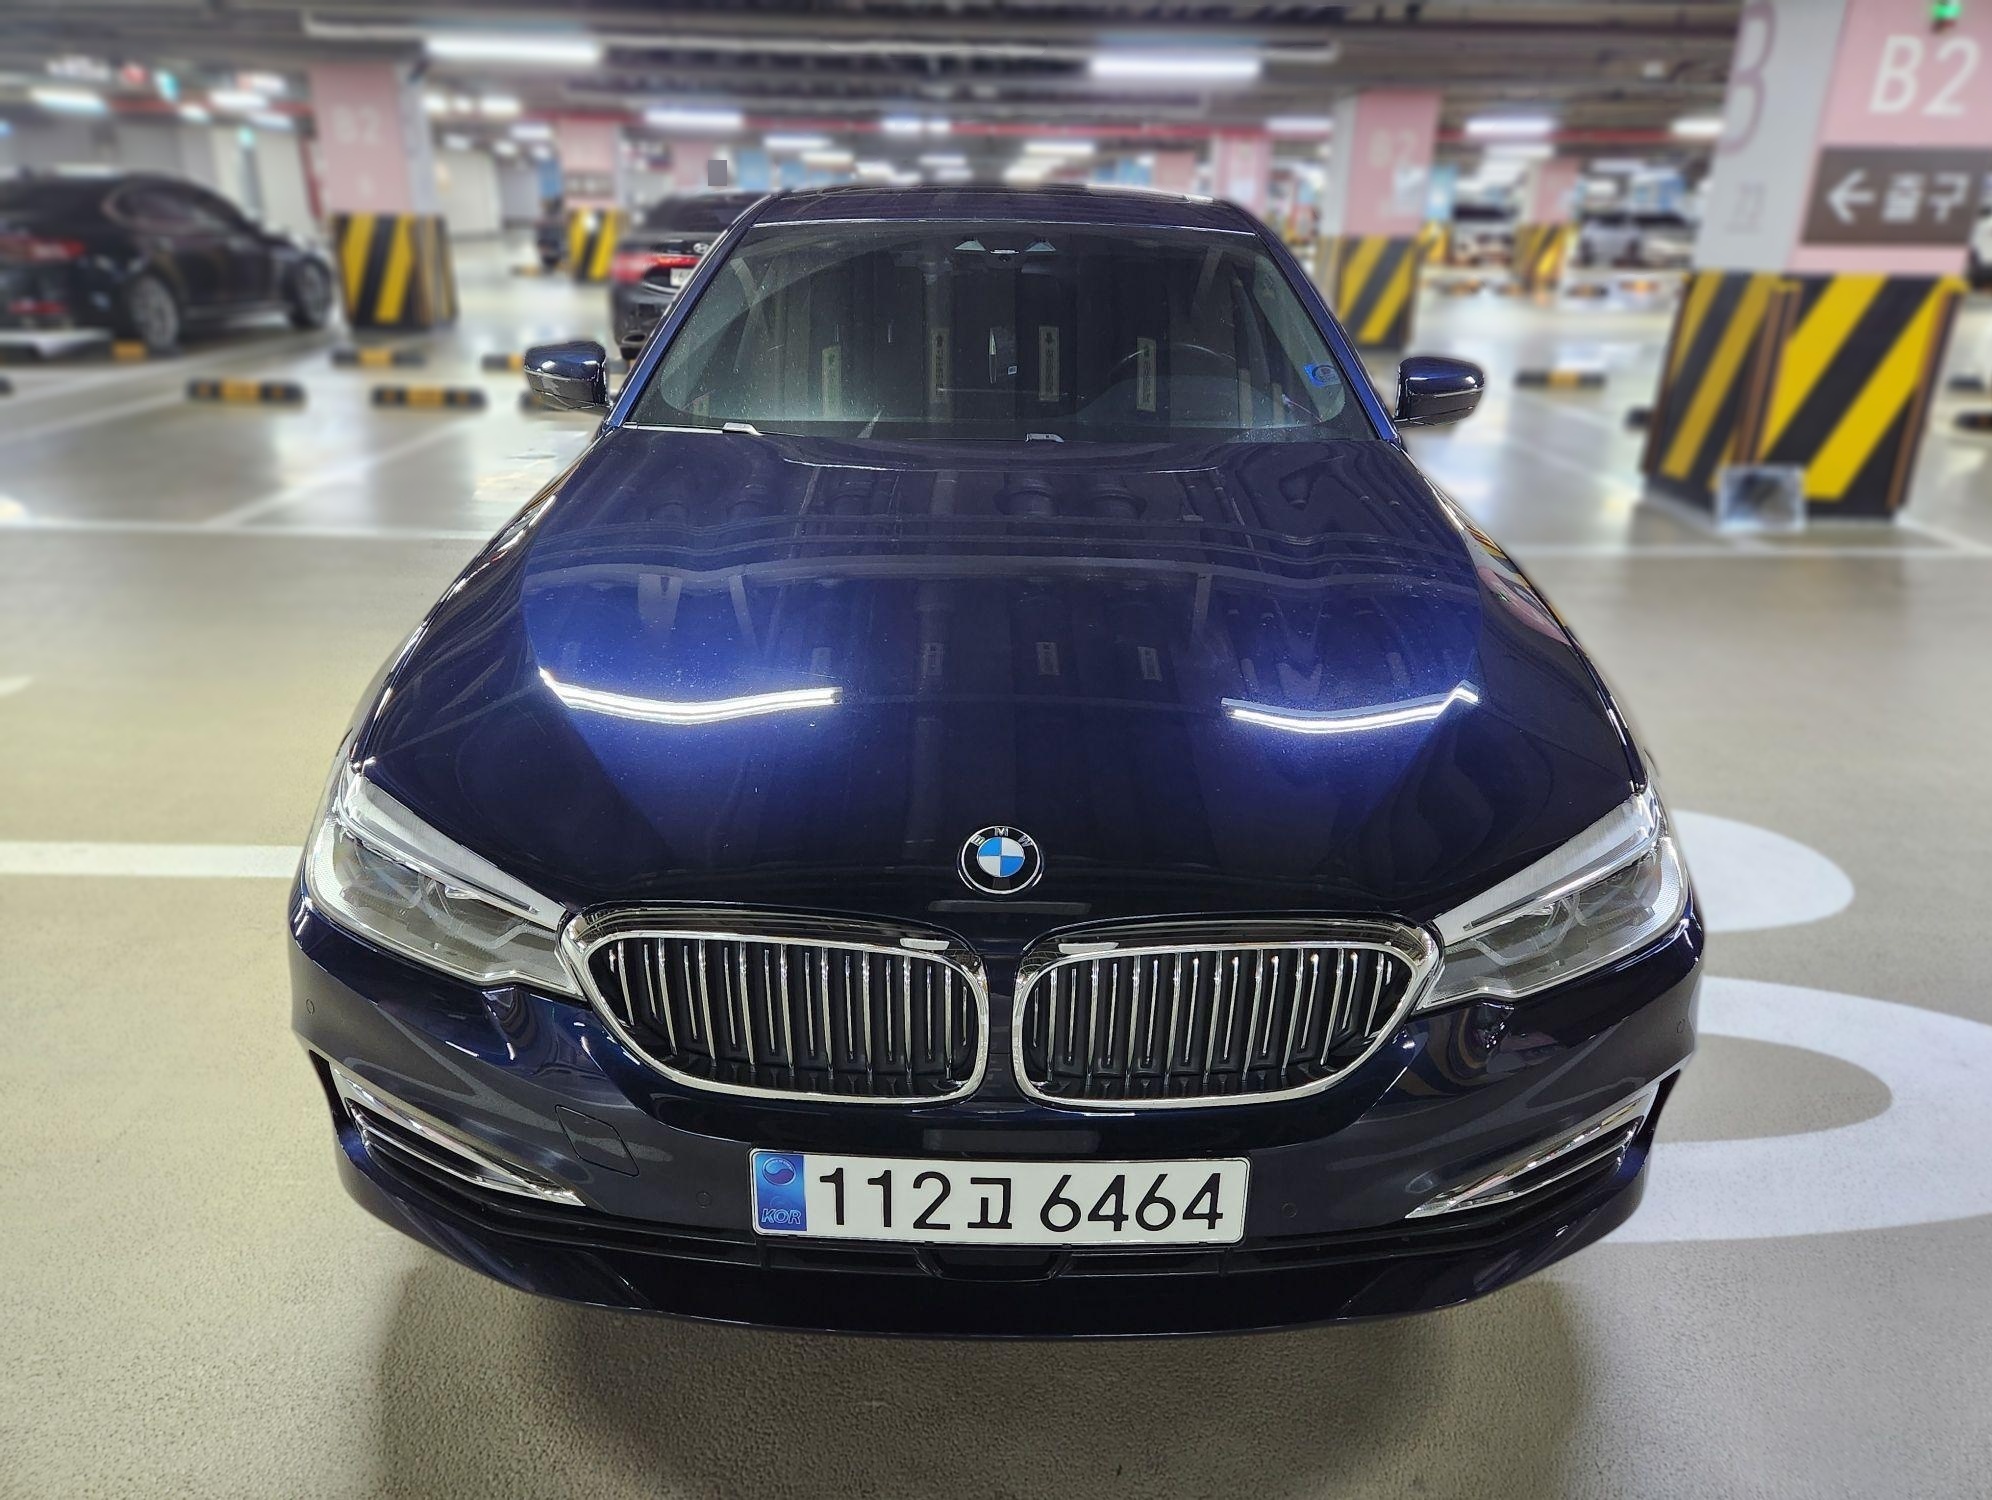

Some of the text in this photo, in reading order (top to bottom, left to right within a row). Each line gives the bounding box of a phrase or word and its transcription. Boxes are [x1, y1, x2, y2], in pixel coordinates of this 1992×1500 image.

[1869, 35, 1981, 116] B2
[1883, 173, 1970, 223] 출구
[970, 827, 1033, 848] BMW
[761, 1208, 802, 1225] KOR
[819, 1167, 1224, 1233] 112고 6464
